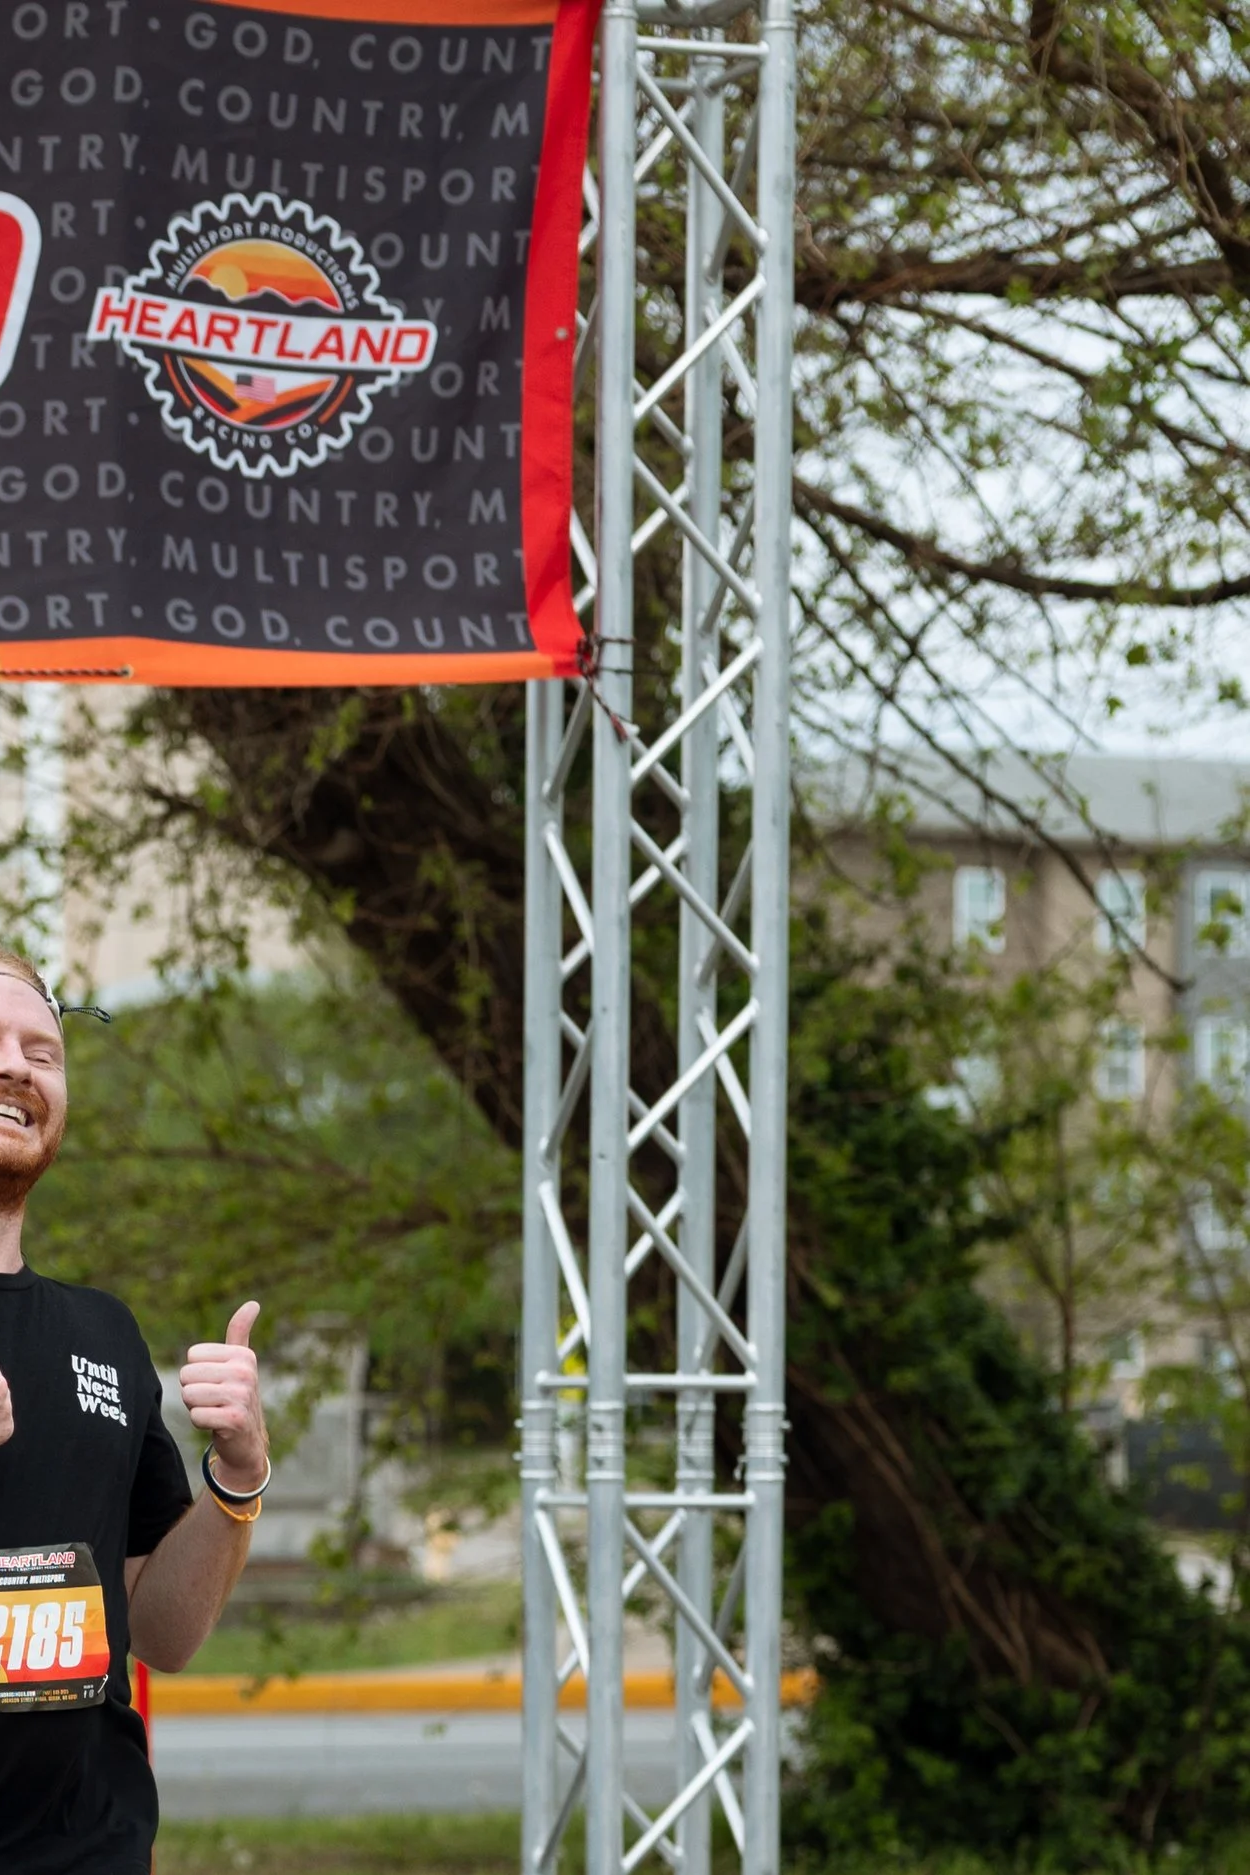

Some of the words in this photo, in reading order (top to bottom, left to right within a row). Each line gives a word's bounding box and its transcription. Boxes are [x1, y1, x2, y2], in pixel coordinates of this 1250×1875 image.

[184, 12, 320, 69] GOD,
[349, 33, 552, 74] COUNT
[10, 65, 149, 109] GOD,
[179, 79, 464, 142] COUNTRY,
[492, 102, 529, 139] M
[171, 144, 540, 205] MULTISPOR
[167, 221, 253, 288] MULTISPORT
[259, 222, 360, 310] PRODUCTIONS
[93, 292, 433, 367] HEARTLAND
[192, 406, 273, 448] RACING
[159, 470, 441, 529] COUNTRY,
[162, 534, 523, 590] MULTISPOR
[166, 598, 301, 647] GOD,
[326, 612, 529, 649] COUNT
[71, 1353, 119, 1387] Until
[76, 1374, 121, 1403] Next
